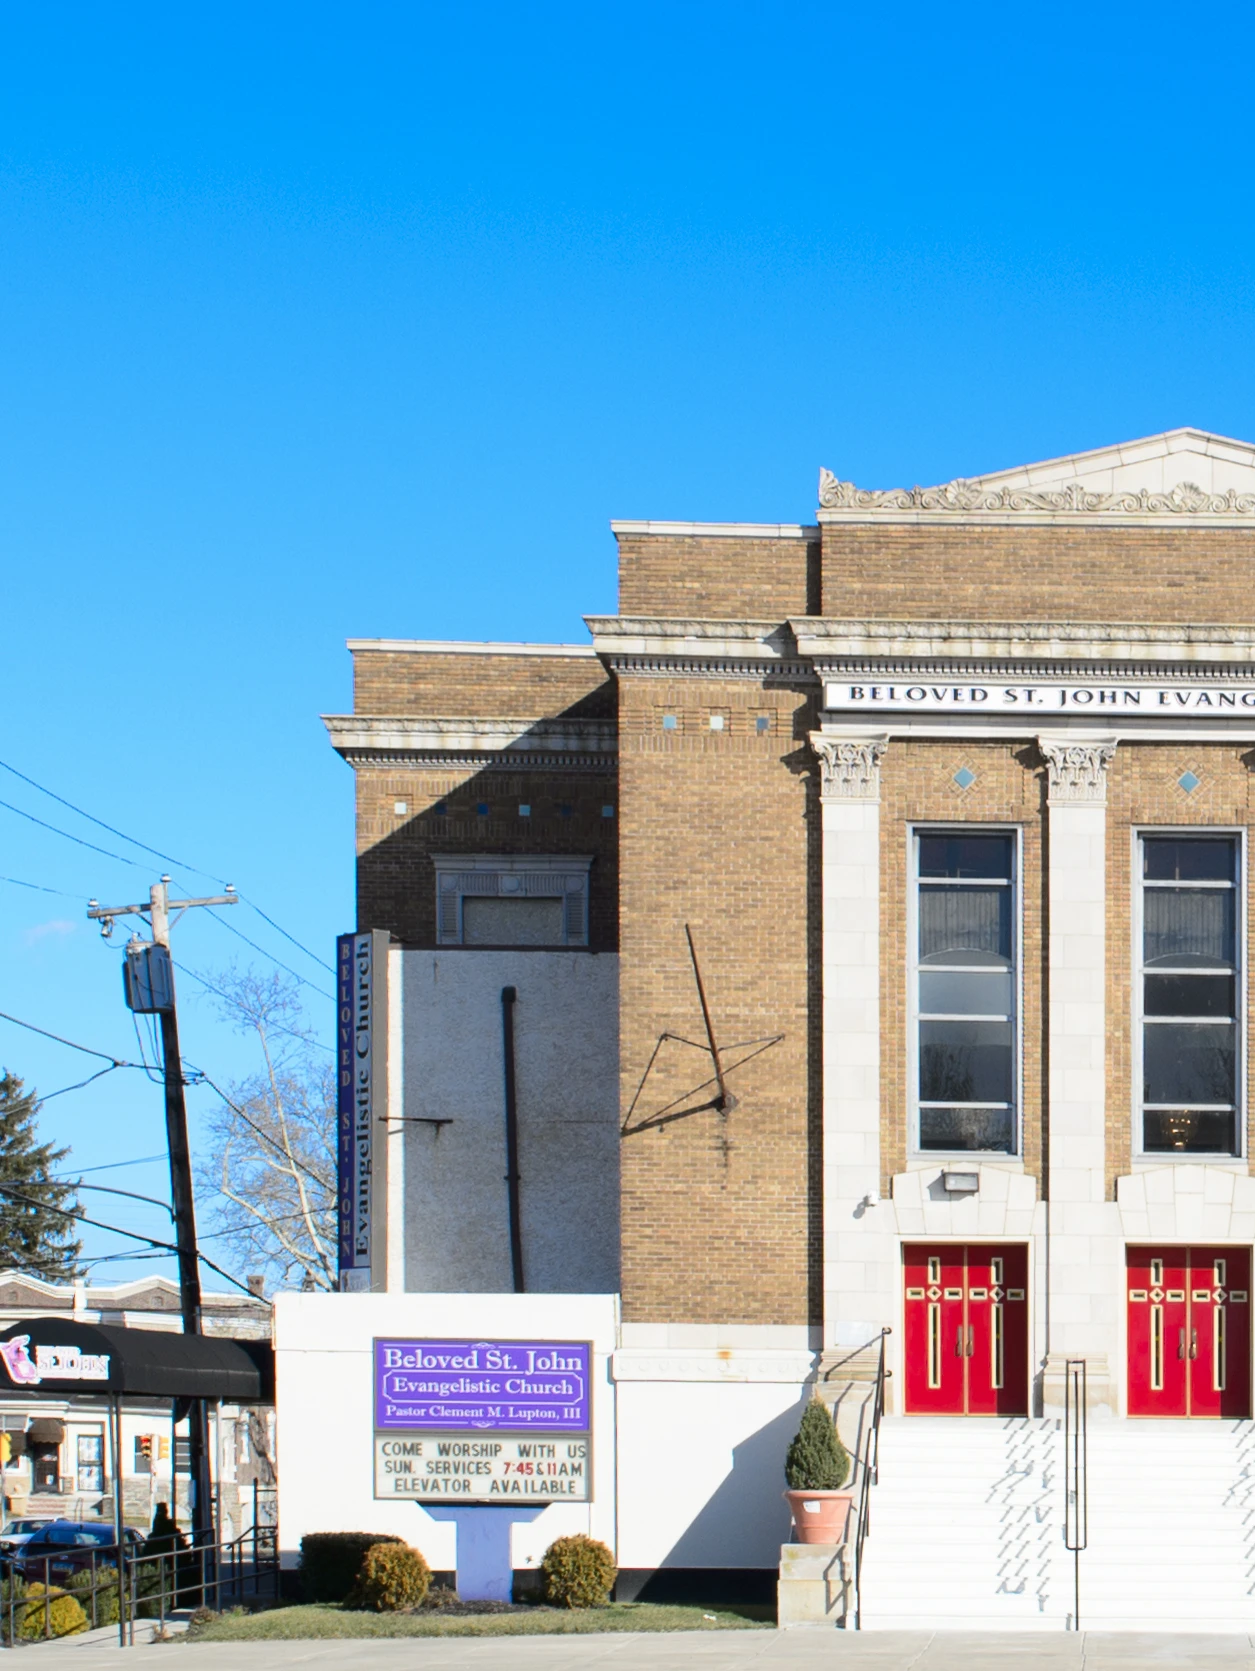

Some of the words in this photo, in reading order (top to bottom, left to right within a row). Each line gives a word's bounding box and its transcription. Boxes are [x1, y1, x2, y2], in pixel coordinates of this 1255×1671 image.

[850, 686, 989, 702] BELOVED
[1003, 688, 1044, 704] ST.
[1058, 689, 1141, 707] JOHN
[356, 942, 370, 1060] Church
[341, 943, 351, 1087] BELOVED
[356, 1071, 372, 1256] Evangelistic
[342, 1177, 351, 1257] JOHN
[383, 1348, 479, 1369] Beloved
[486, 1350, 518, 1370] St.
[525, 1351, 583, 1375] John
[393, 1377, 500, 1396] Evangelistic
[505, 1379, 573, 1395] Church
[386, 1405, 426, 1417] Pastor
[429, 1405, 484, 1418] Clement
[487, 1406, 505, 1418] M.
[508, 1407, 560, 1421] Lupton,
[563, 1407, 581, 1419] III
[381, 1441, 423, 1456] COME
[437, 1443, 502, 1457] WORSHIP
[518, 1444, 556, 1459] WITH
[567, 1445, 587, 1459] US
[384, 1460, 416, 1475] SUN.
[426, 1461, 492, 1475] SERVICES
[394, 1478, 471, 1493] ELEVATOR
[490, 1479, 576, 1494] AVAILABLE
